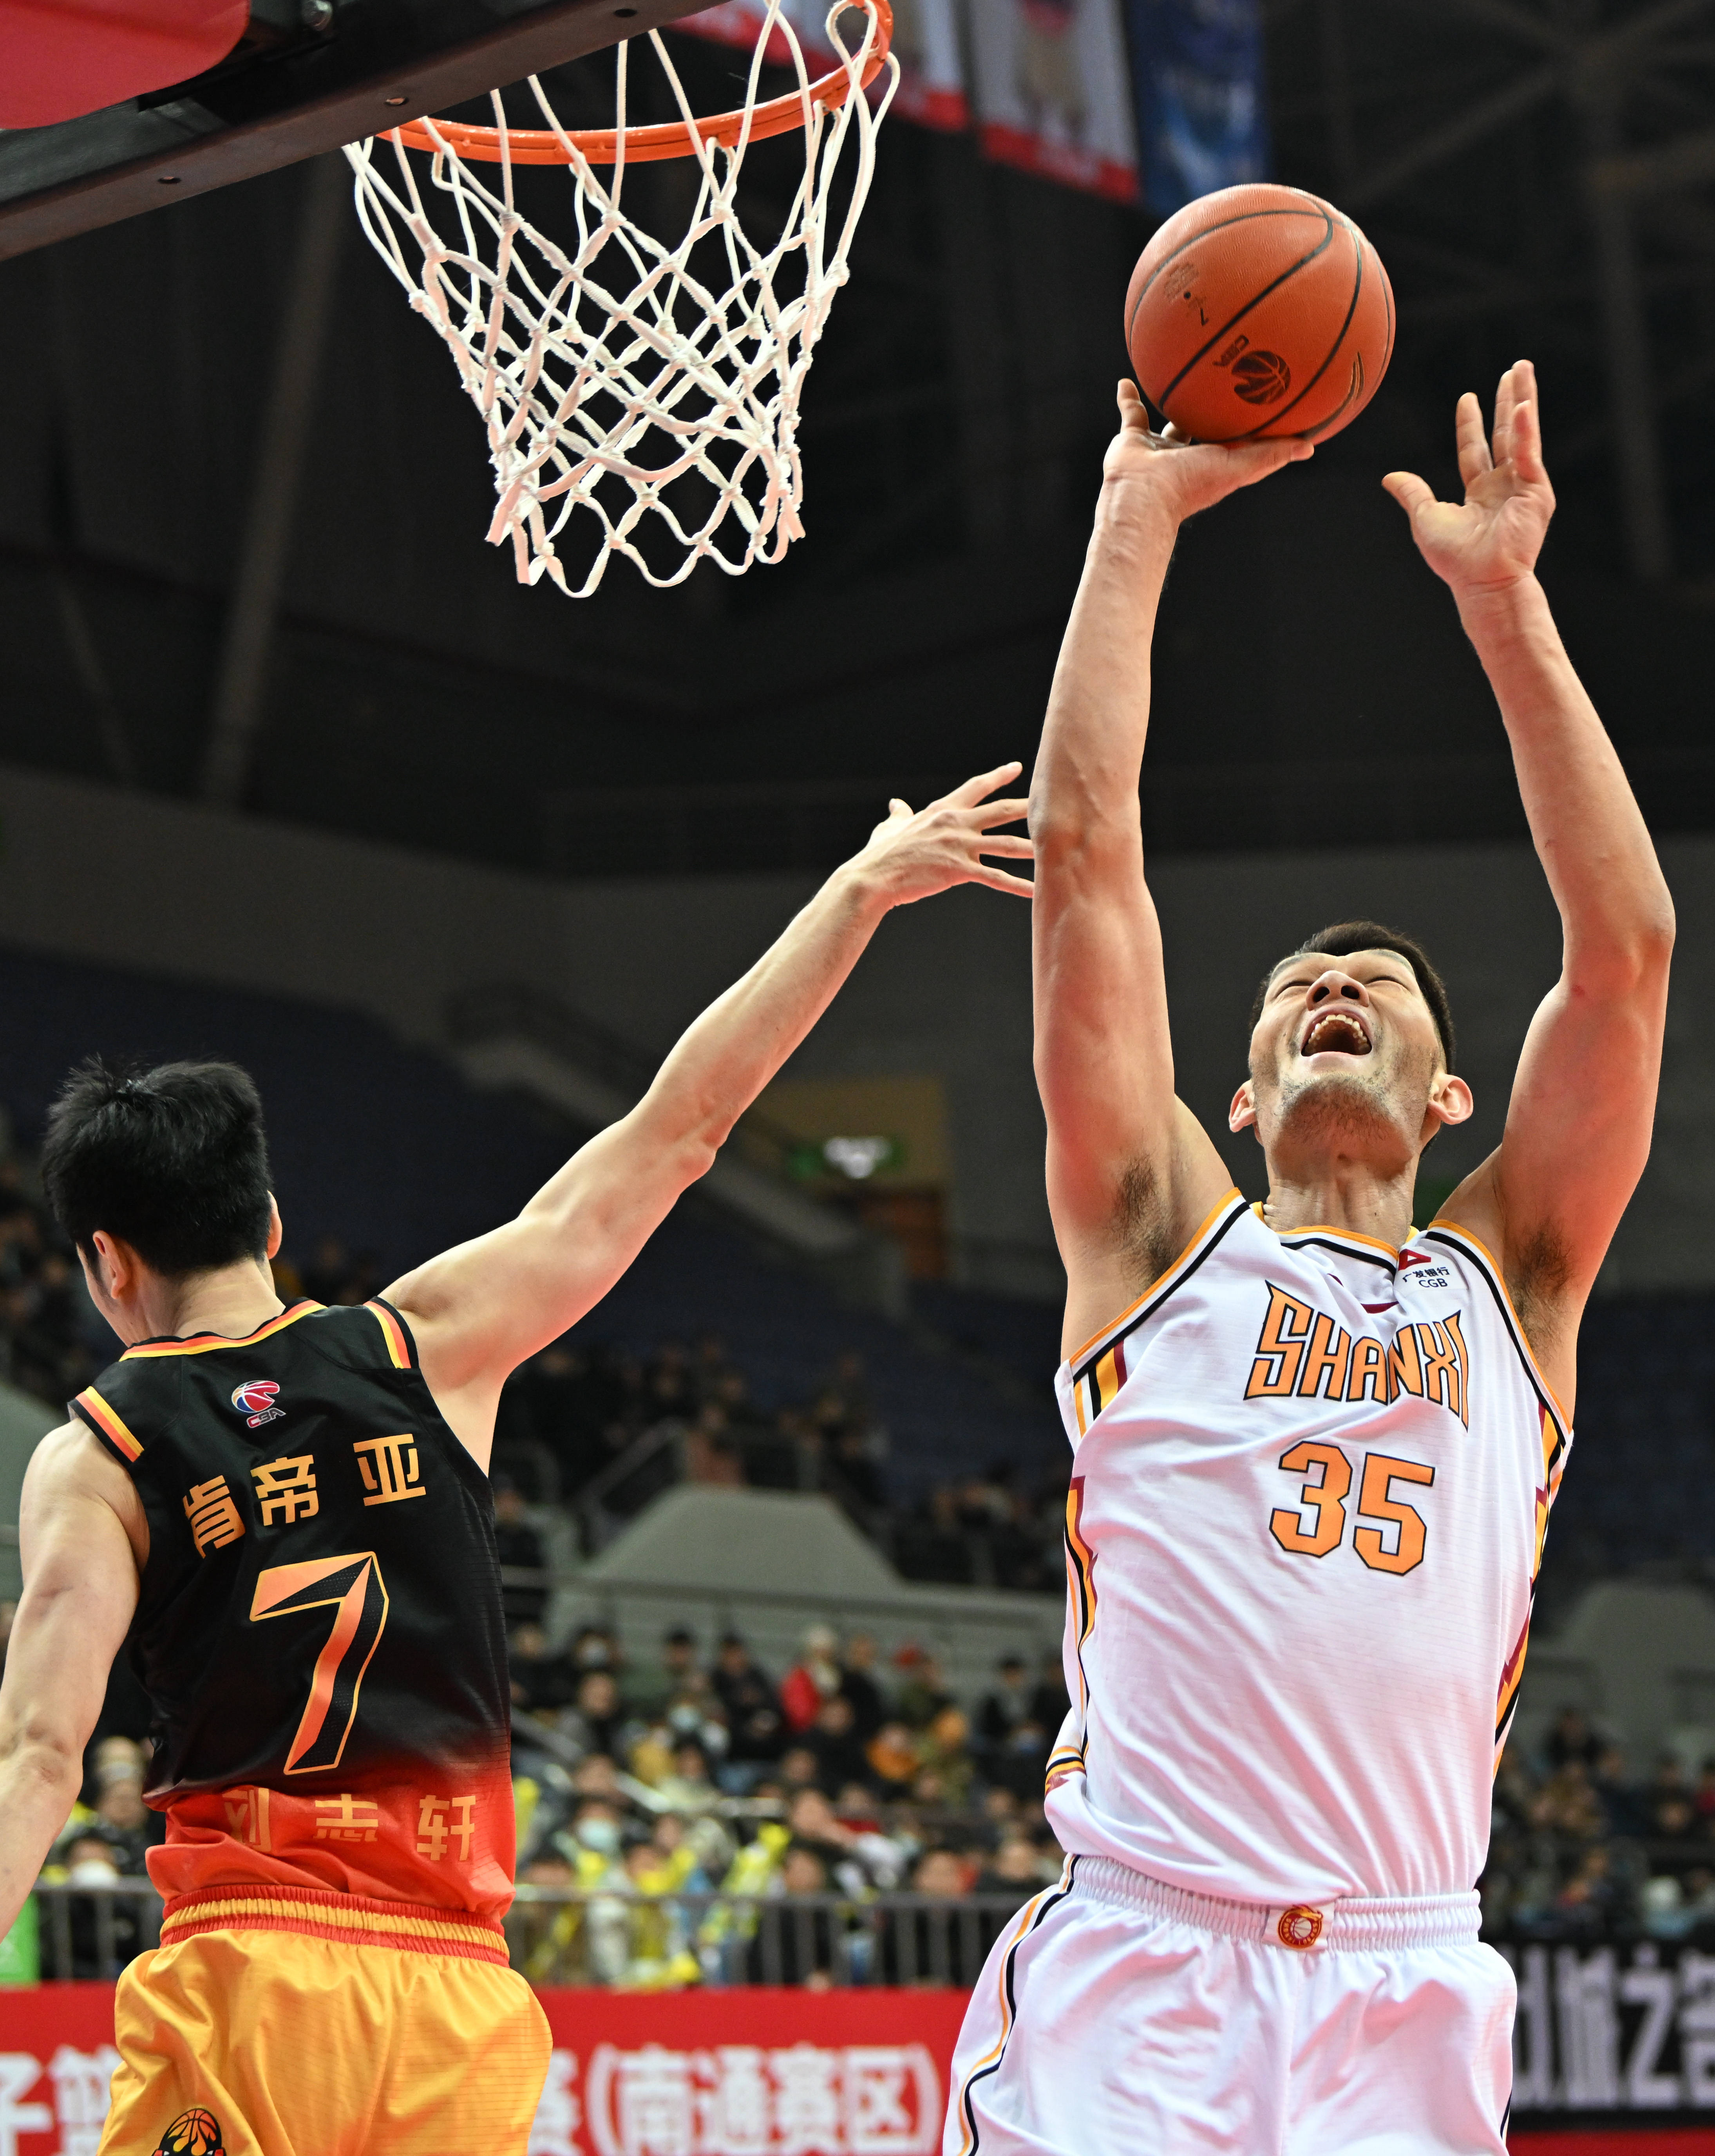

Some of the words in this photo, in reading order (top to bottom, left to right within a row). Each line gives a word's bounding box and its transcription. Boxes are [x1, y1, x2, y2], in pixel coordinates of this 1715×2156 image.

[1402, 1266, 1450, 1282] 广发银行
[1418, 1278, 1448, 1288] CGB
[1243, 1279, 1469, 1433] SHANXI
[246, 1407, 287, 1428] CBA
[182, 1433, 427, 1559] 肯帝亚
[1269, 1440, 1436, 1576] 35
[249, 1551, 389, 1775] 7
[222, 1787, 476, 1861] 刘志轩
